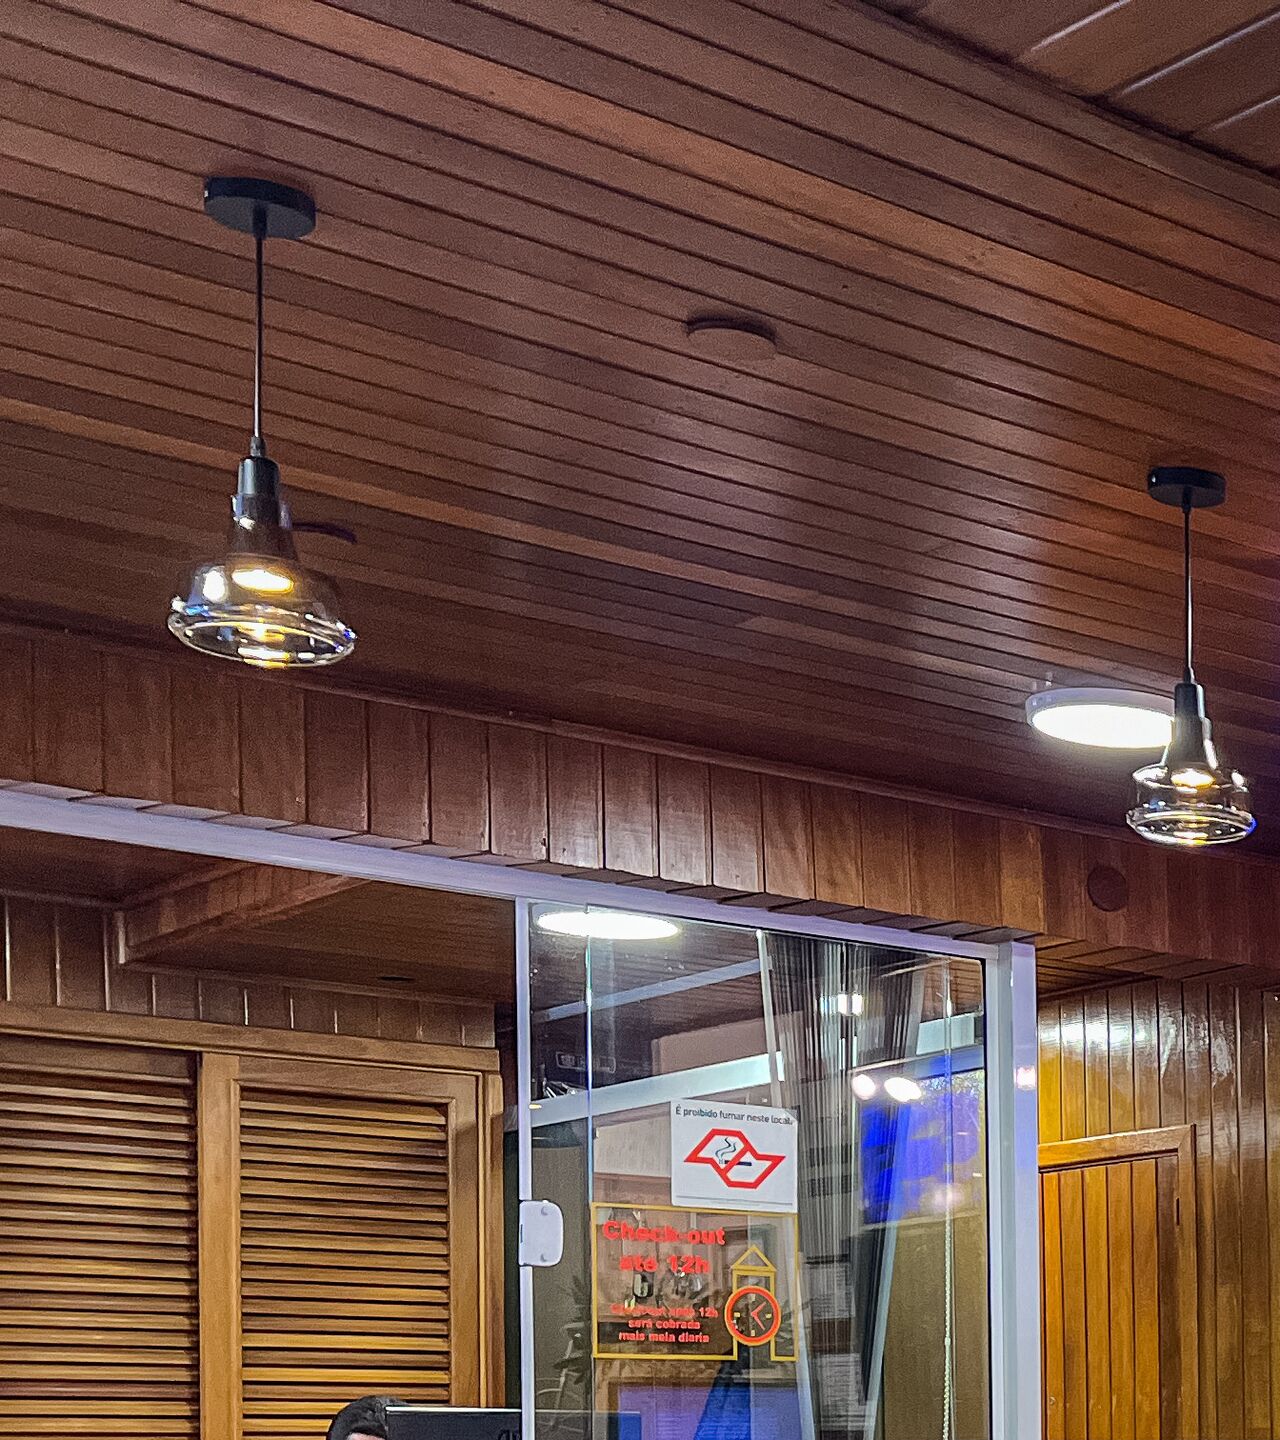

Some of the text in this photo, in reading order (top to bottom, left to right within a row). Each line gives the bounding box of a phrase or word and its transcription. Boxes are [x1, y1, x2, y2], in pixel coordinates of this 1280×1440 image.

[675, 1104, 682, 1115] É
[683, 1108, 718, 1119] proibido
[719, 1110, 746, 1121] fumar
[746, 1114, 770, 1123] neste
[602, 1220, 726, 1245] Check-out
[667, 1255, 710, 1273] 12h
[618, 1329, 646, 1341] mais
